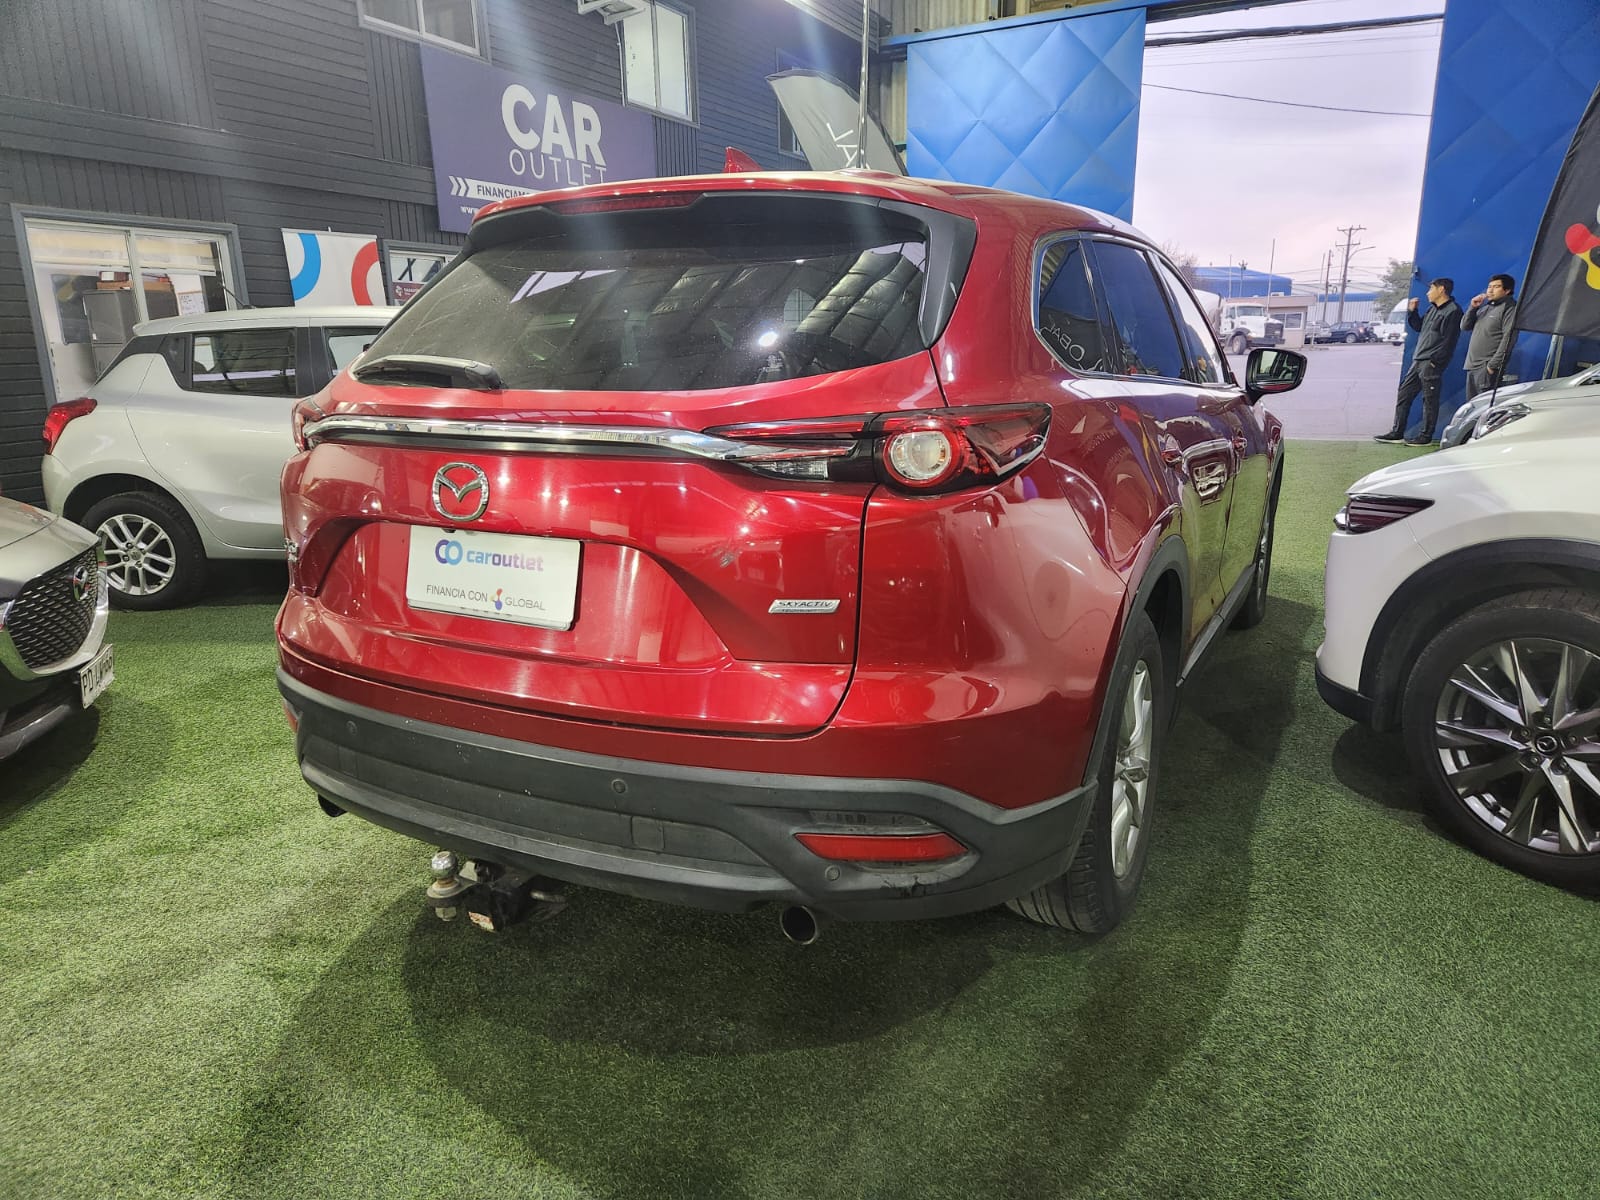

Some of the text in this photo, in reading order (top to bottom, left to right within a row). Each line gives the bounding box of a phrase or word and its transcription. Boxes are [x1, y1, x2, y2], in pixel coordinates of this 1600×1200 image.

[501, 84, 607, 166] CAR
[509, 149, 607, 185] OUTLET
[466, 549, 544, 572] caroutlet
[426, 584, 546, 611] FINANCIA CON GLOBAL
